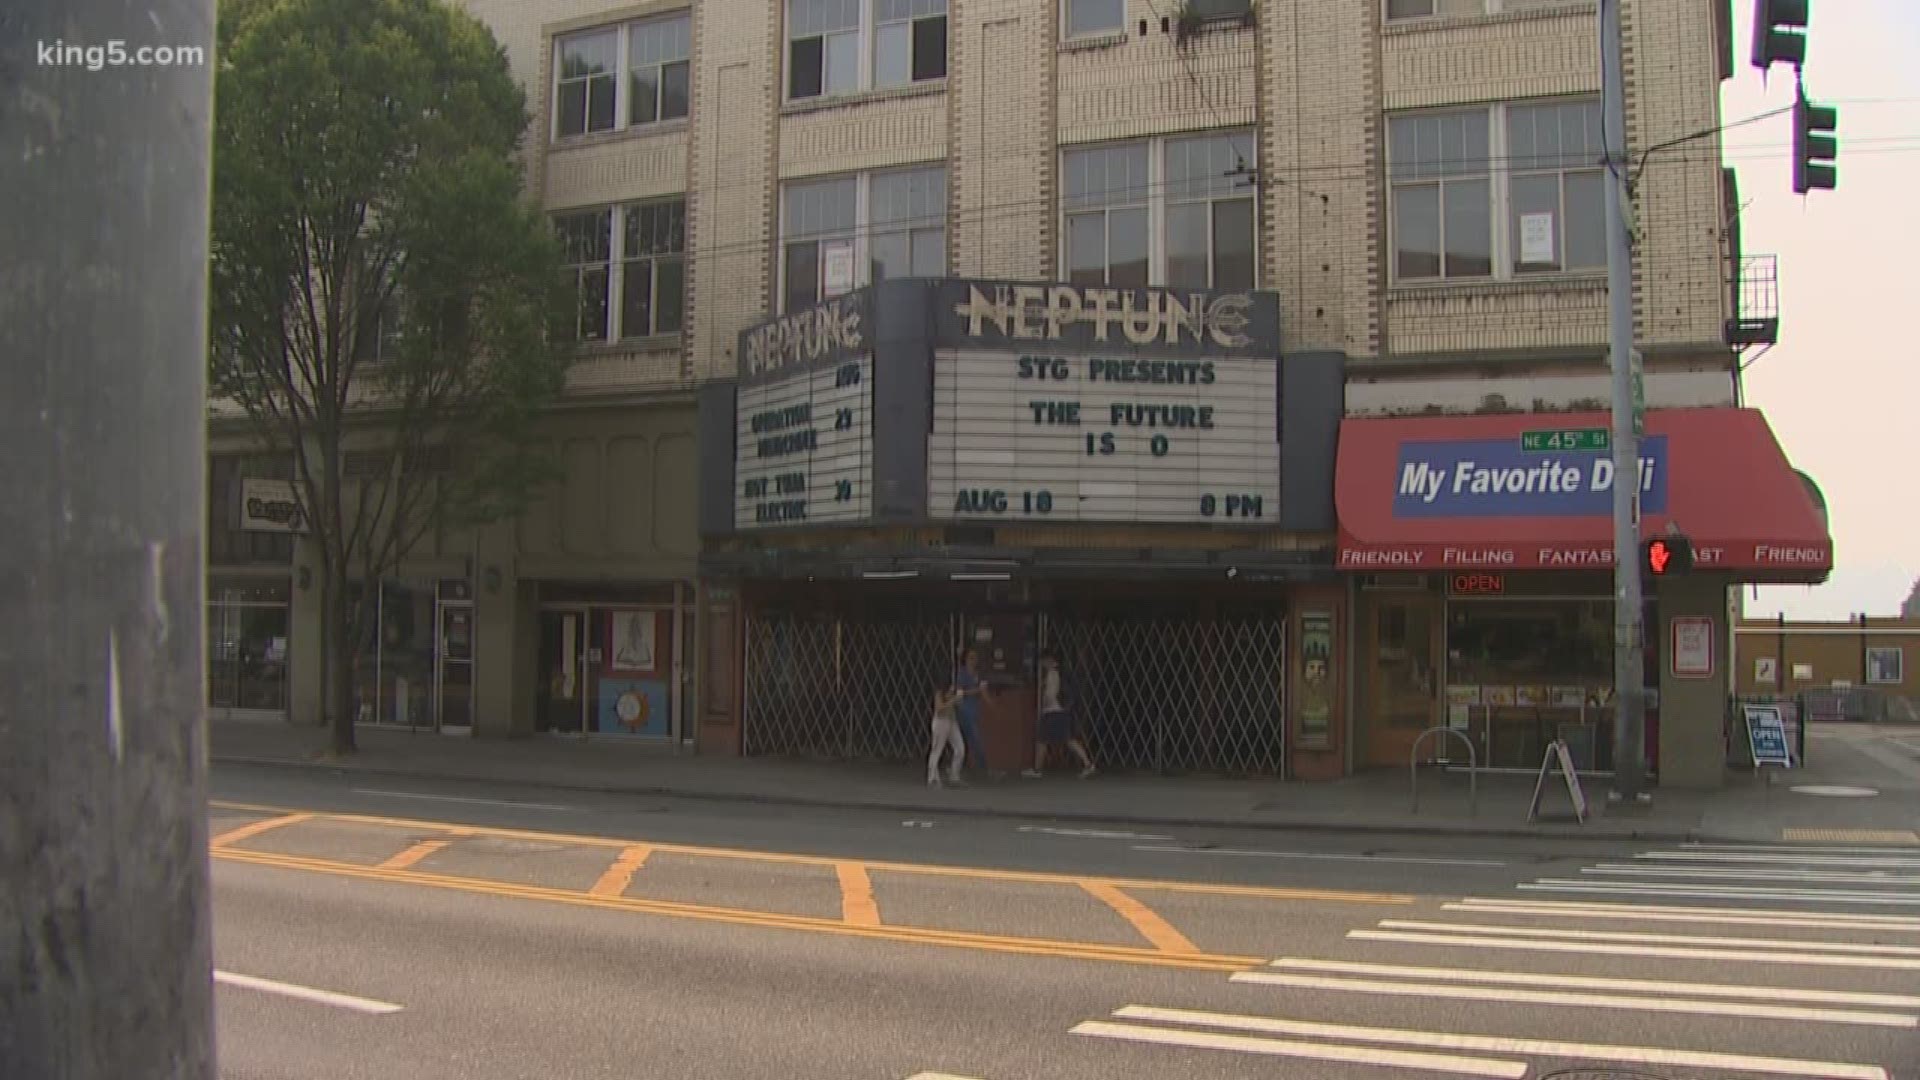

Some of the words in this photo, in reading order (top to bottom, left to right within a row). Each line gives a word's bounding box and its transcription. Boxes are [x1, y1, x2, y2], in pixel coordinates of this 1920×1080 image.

[953, 284, 1254, 347] NEPTUNE
[1018, 355, 1068, 380] STG
[1089, 358, 1215, 384] PRESENTS
[1029, 401, 1080, 426] THE
[1110, 402, 1214, 429] FUTURE
[1087, 431, 1115, 456] IS
[1524, 434, 1541, 447] NE
[1399, 462, 1446, 503] My
[1453, 458, 1581, 493] Favorite
[1591, 457, 1655, 491] Dli
[953, 489, 1007, 513] AUG
[1226, 494, 1262, 516] PM
[1342, 550, 1423, 564] FRIENDLY
[1443, 547, 1515, 564] FILLING
[1455, 576, 1500, 590] OPEN
